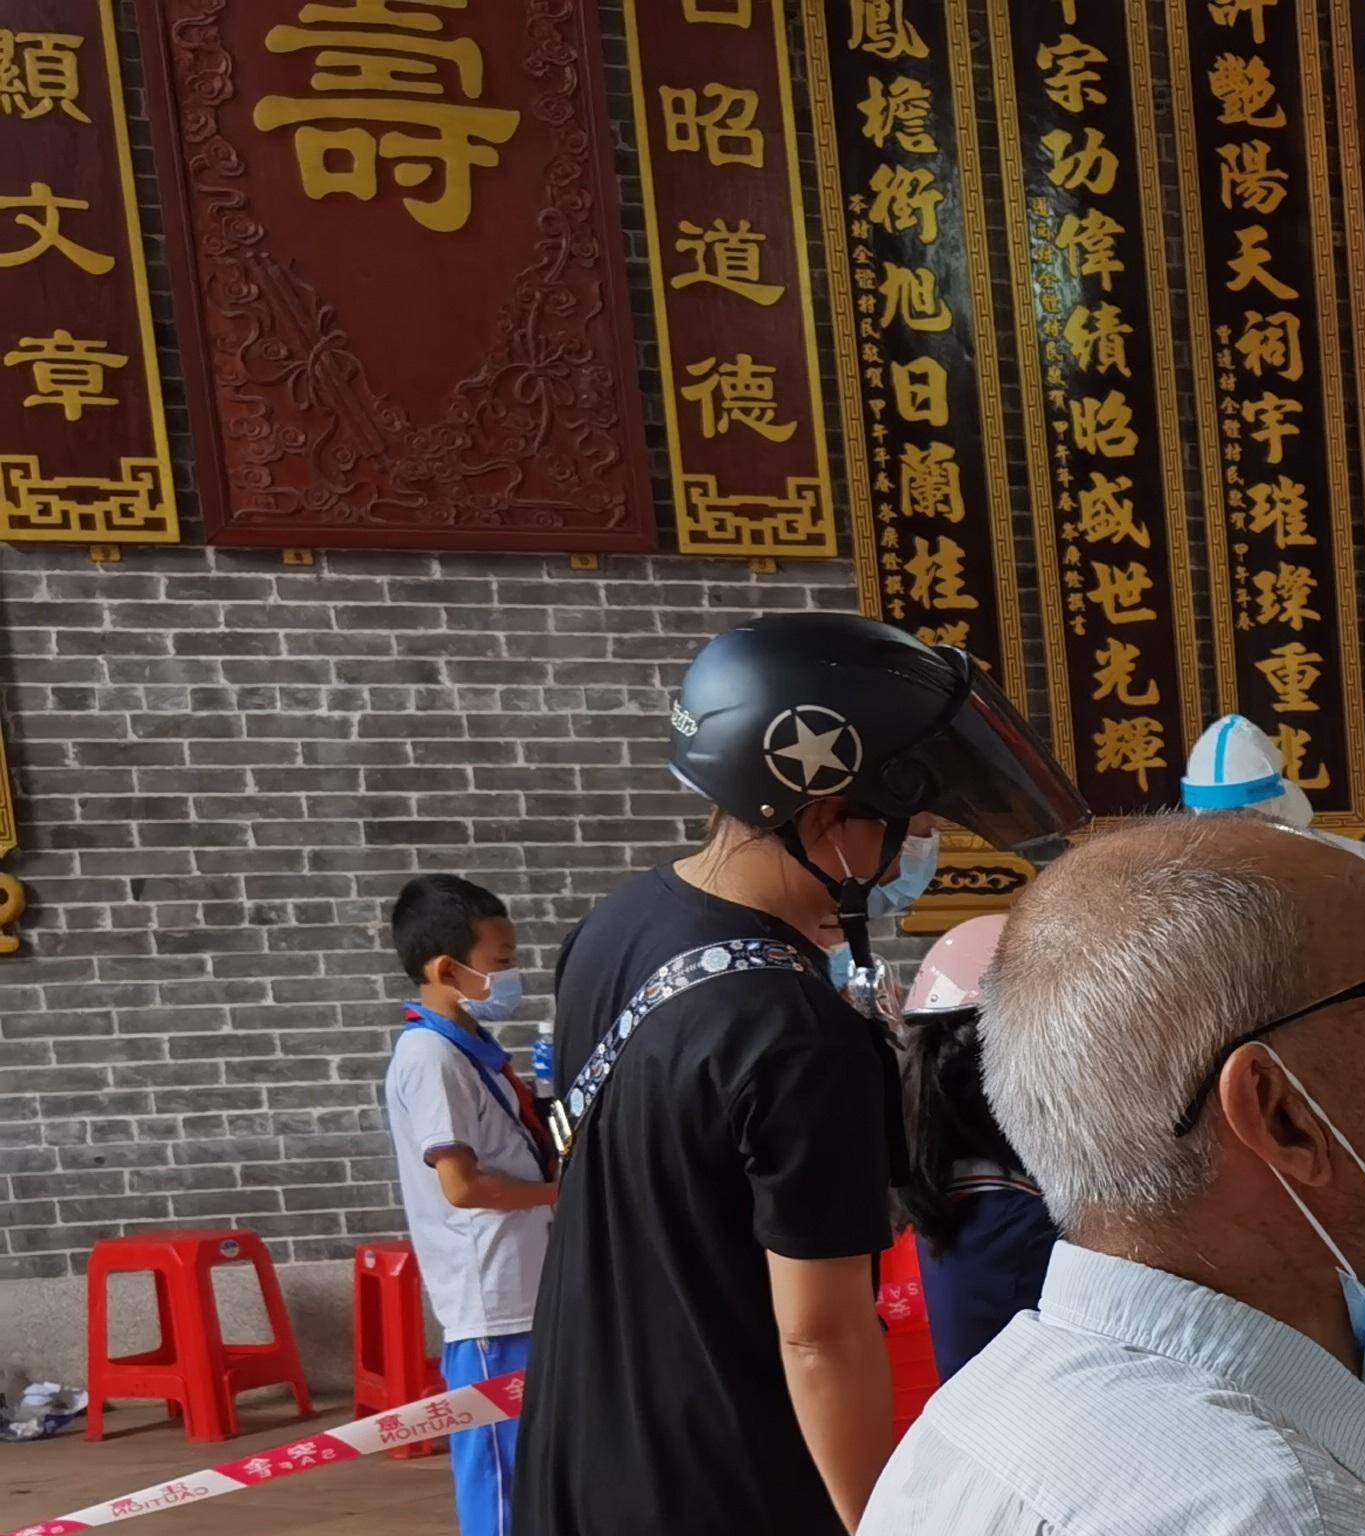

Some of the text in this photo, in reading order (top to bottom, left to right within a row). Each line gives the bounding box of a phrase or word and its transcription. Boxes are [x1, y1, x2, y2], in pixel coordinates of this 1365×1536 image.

[253, 0, 520, 233] 壽
[1036, 0, 1168, 792] 宗功偉績昭盛世光輝
